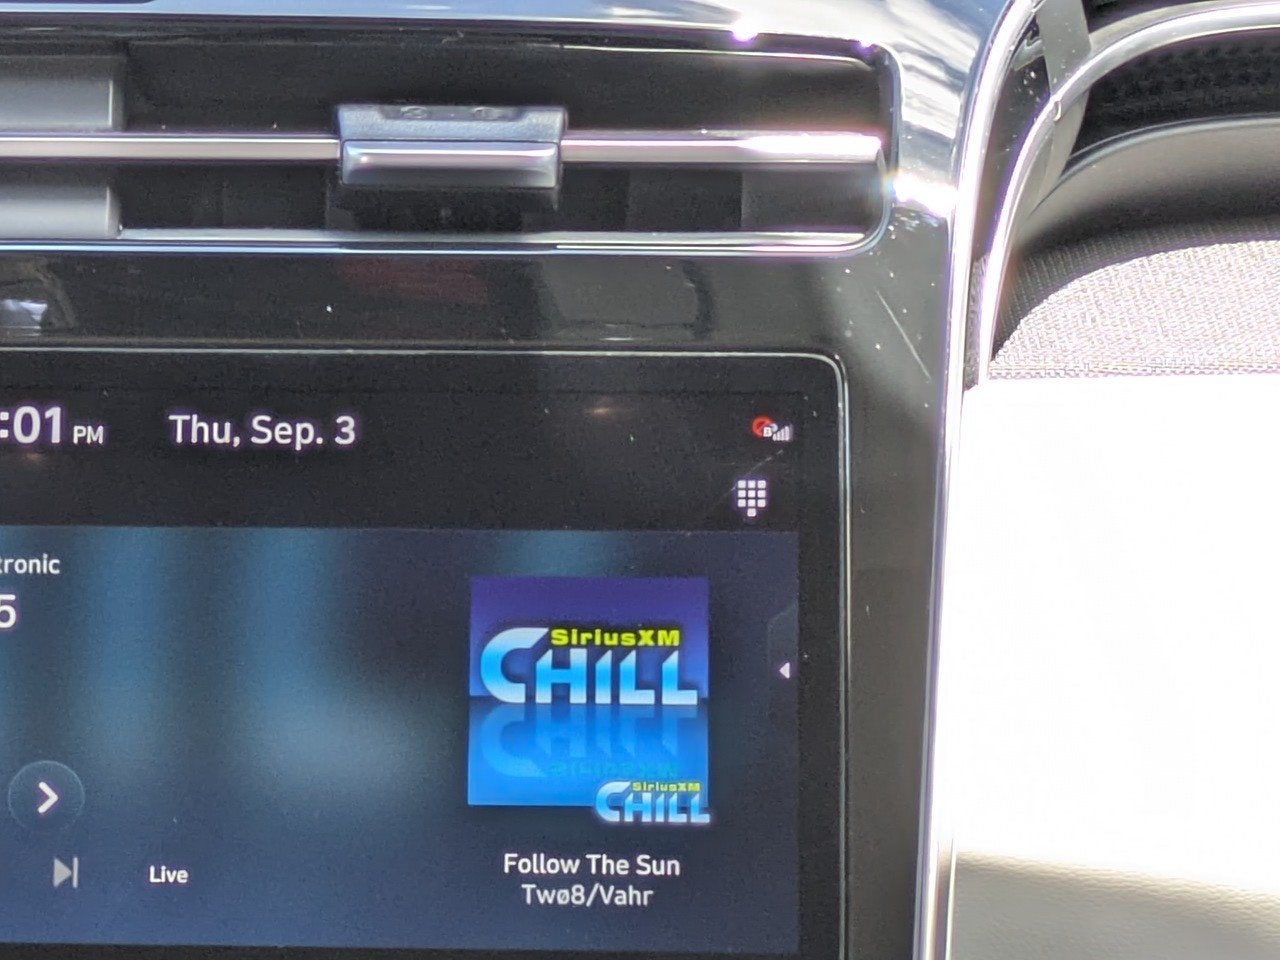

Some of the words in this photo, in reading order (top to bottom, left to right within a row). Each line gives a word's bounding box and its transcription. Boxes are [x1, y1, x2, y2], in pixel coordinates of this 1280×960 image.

[72, 424, 105, 445] PM
[168, 414, 243, 447] Thu,
[249, 414, 325, 450] Sep.
[333, 414, 357, 446] 3
[551, 629, 680, 647] SiriusXM
[480, 626, 699, 706] CHILL
[595, 781, 711, 824] CHILL
[149, 864, 190, 885] Live
[503, 853, 581, 875] Follow
[587, 854, 629, 876] The
[636, 854, 682, 877] Sun
